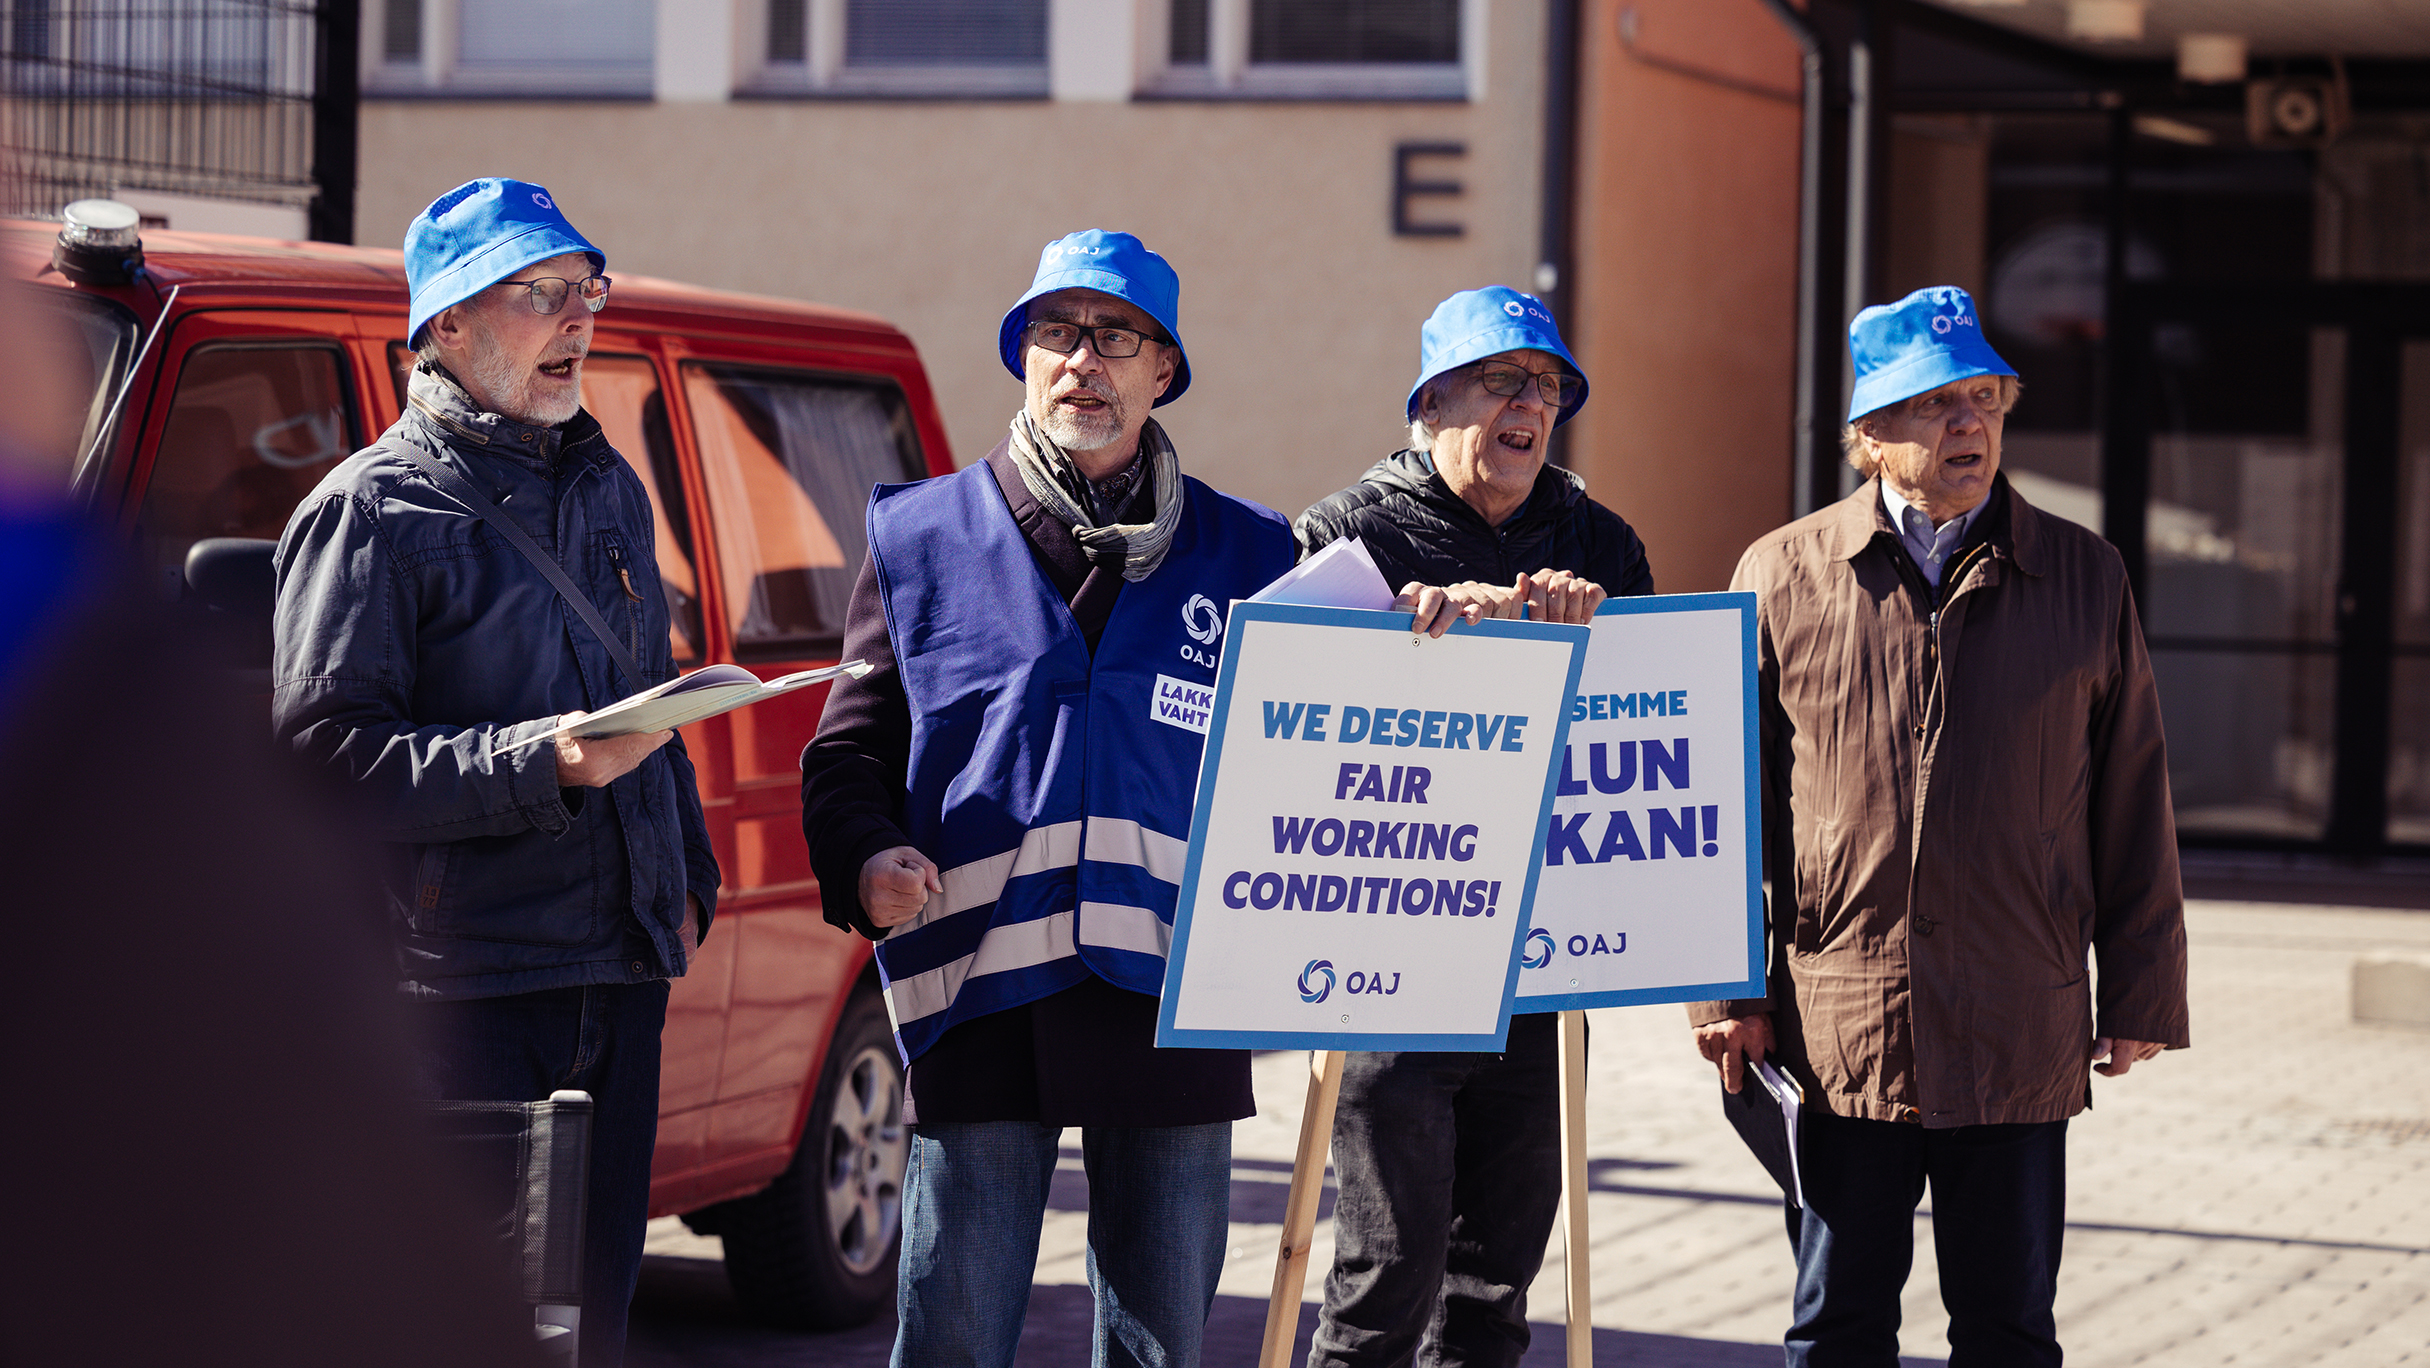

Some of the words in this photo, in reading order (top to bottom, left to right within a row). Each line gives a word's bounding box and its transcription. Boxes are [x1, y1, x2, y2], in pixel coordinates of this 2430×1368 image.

[1392, 141, 1467, 238] E
[1067, 246, 1100, 255] OAJ
[1180, 644, 1216, 669] OAJ
[1160, 682, 1213, 710] LAKK
[1571, 689, 1688, 722] SEMME
[1158, 700, 1209, 728] VAHT
[1262, 700, 1332, 742] WE
[1337, 705, 1529, 753] DESERVE
[1334, 762, 1432, 805] FAIR
[1556, 737, 1691, 797] LUN
[1272, 815, 1479, 862] WORKING
[1222, 871, 1502, 918] CONDITIONS!
[1567, 932, 1628, 957] OAJ
[1345, 971, 1401, 996] OAJ
